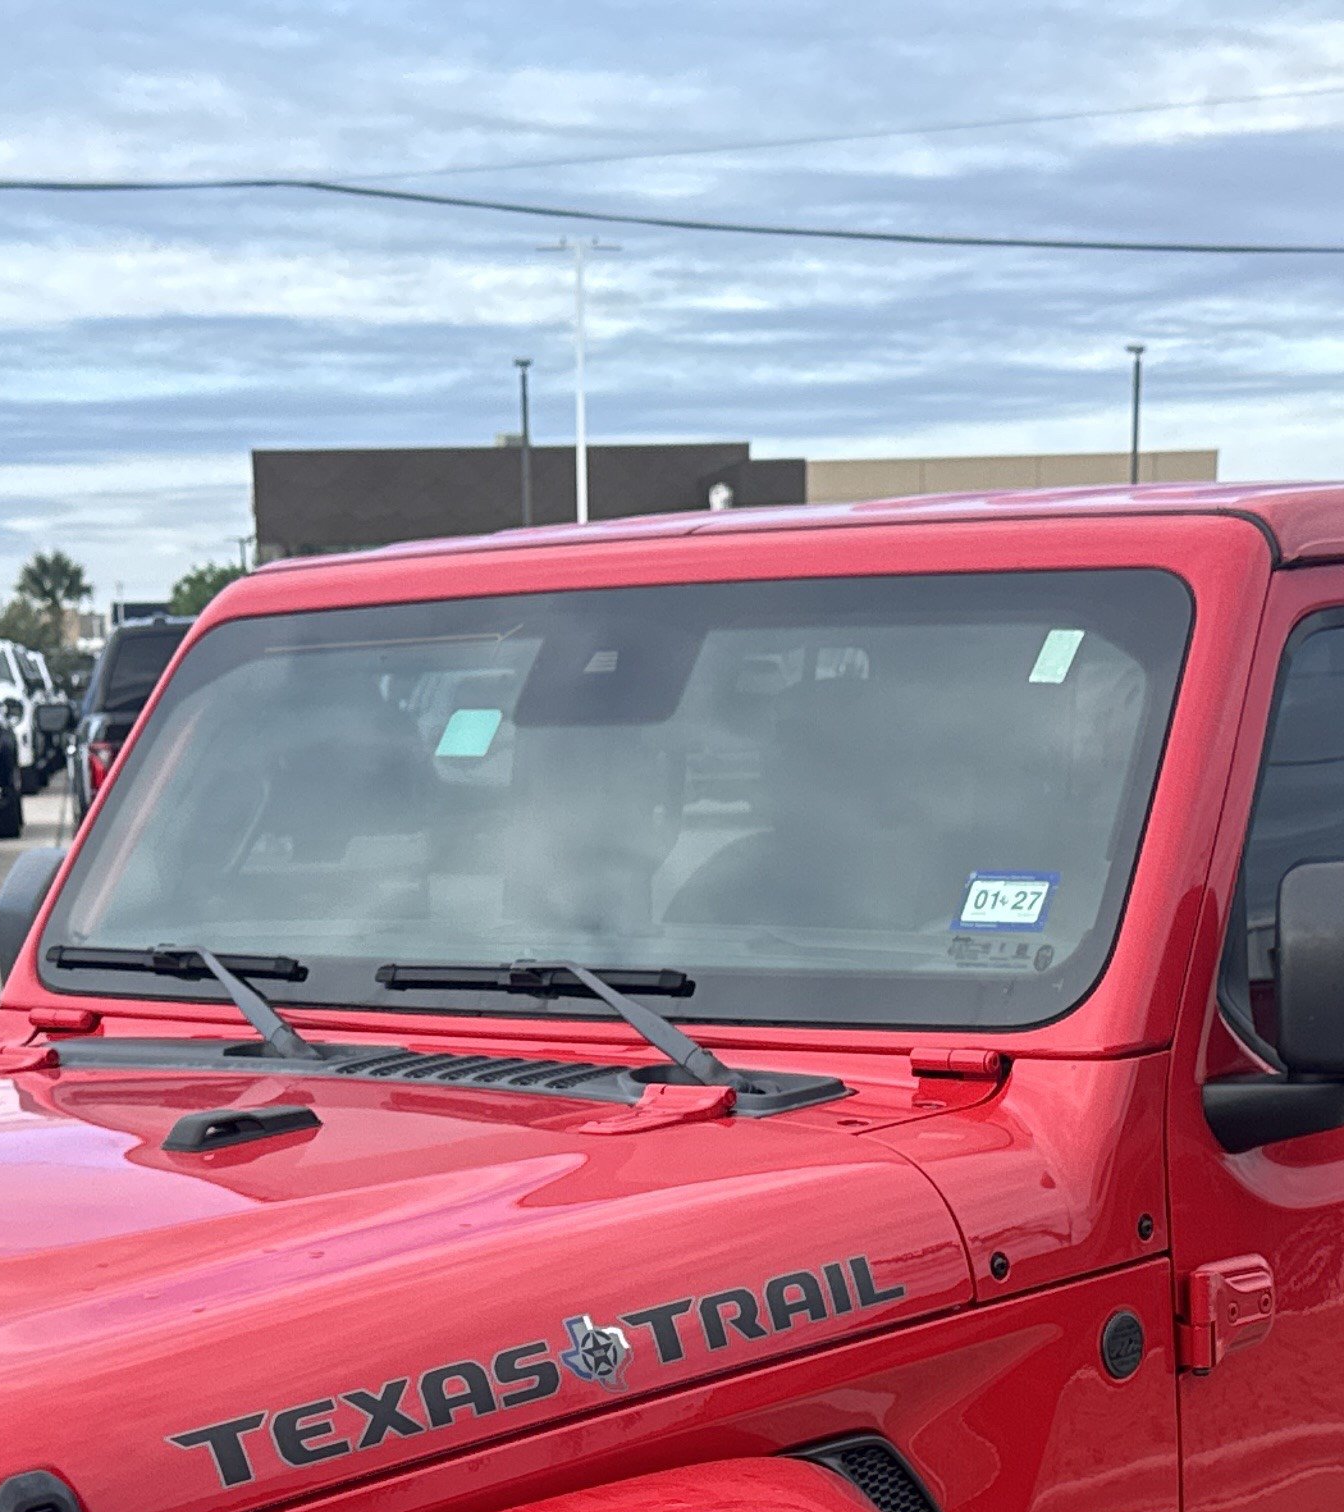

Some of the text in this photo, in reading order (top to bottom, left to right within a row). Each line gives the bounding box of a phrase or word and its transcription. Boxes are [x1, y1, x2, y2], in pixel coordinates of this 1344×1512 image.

[973, 889, 1044, 911] 01 27
[165, 1255, 906, 1488] TEXAS TRAIL
